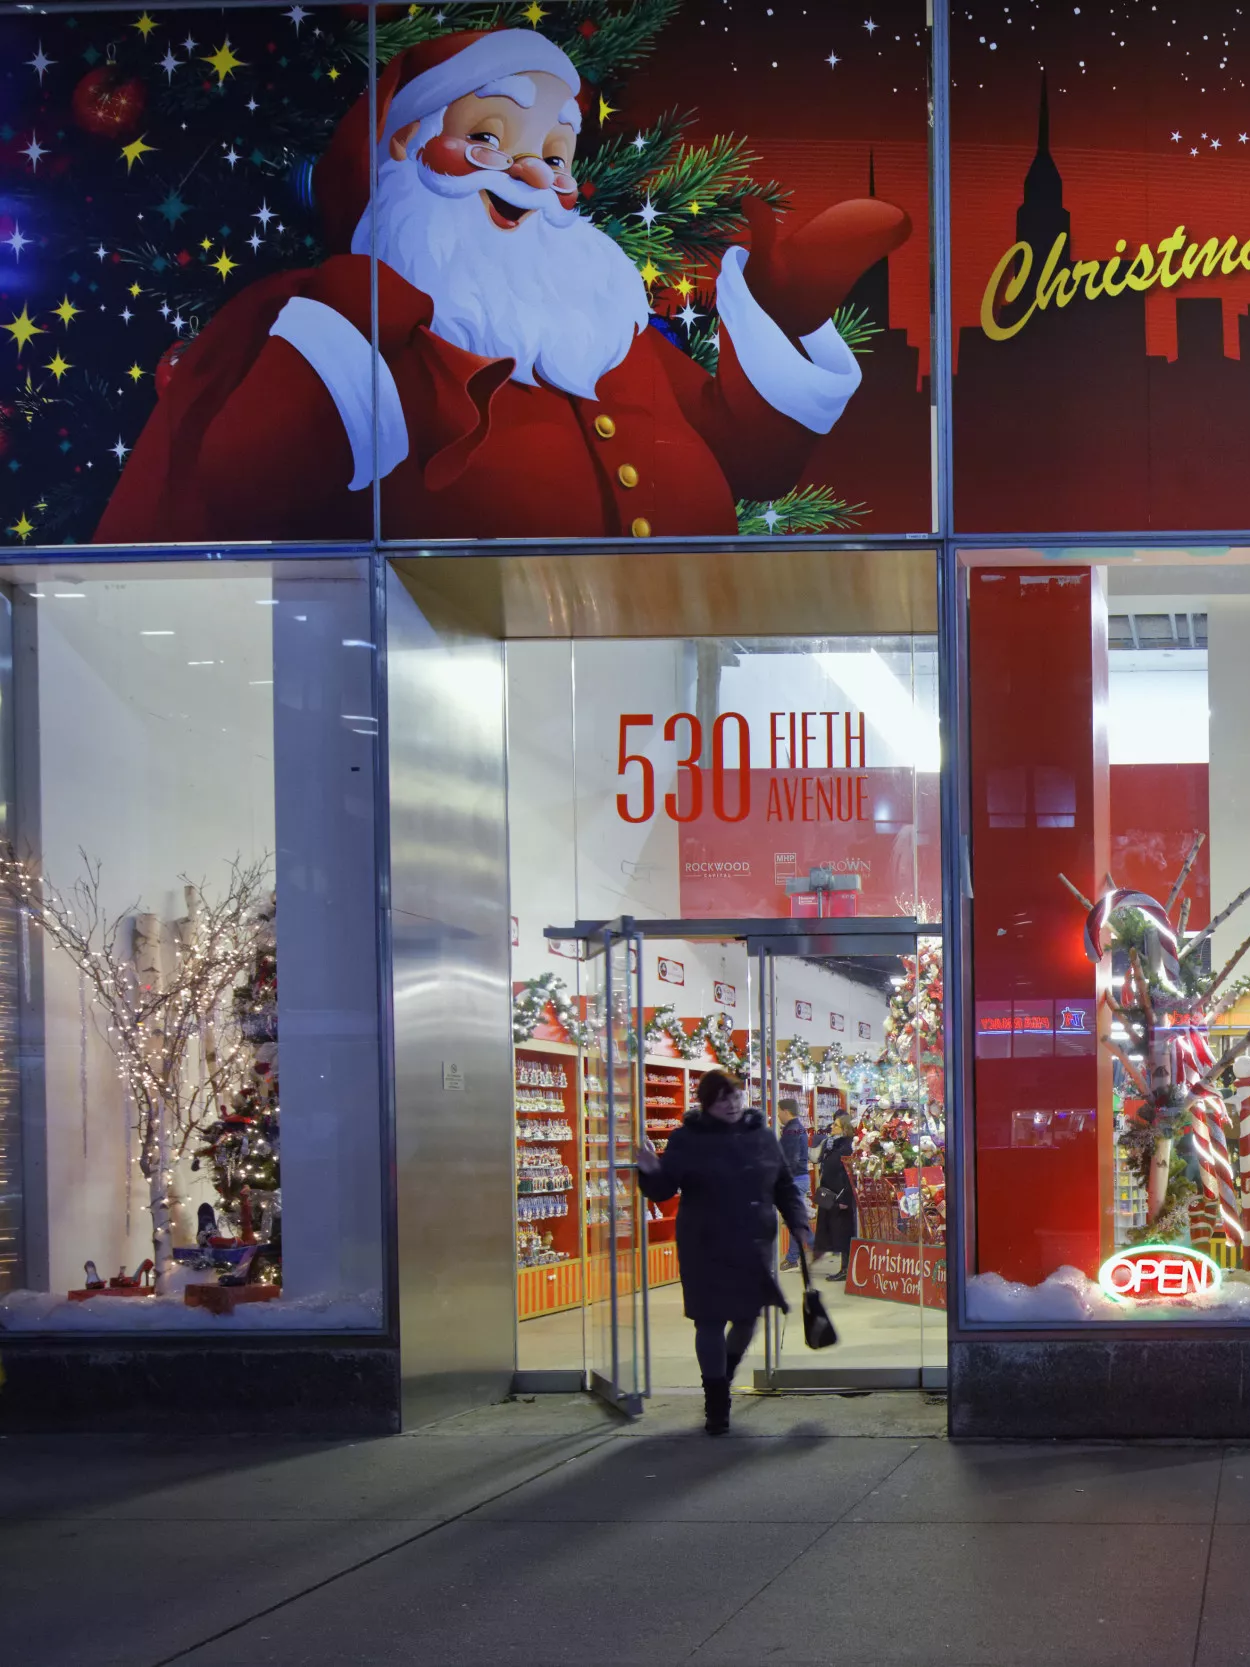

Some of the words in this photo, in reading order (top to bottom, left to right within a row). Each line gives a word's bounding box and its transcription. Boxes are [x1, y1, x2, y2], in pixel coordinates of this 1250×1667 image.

[616, 712, 750, 823] 530
[770, 711, 865, 768] FIFTH
[766, 775, 869, 822] AVENUE
[685, 862, 750, 872] ROCKWOOD
[820, 858, 872, 872] CROWN
[852, 1245, 930, 1287] Christmas
[873, 1273, 898, 1295] New
[1110, 1258, 1209, 1295] OPEN
